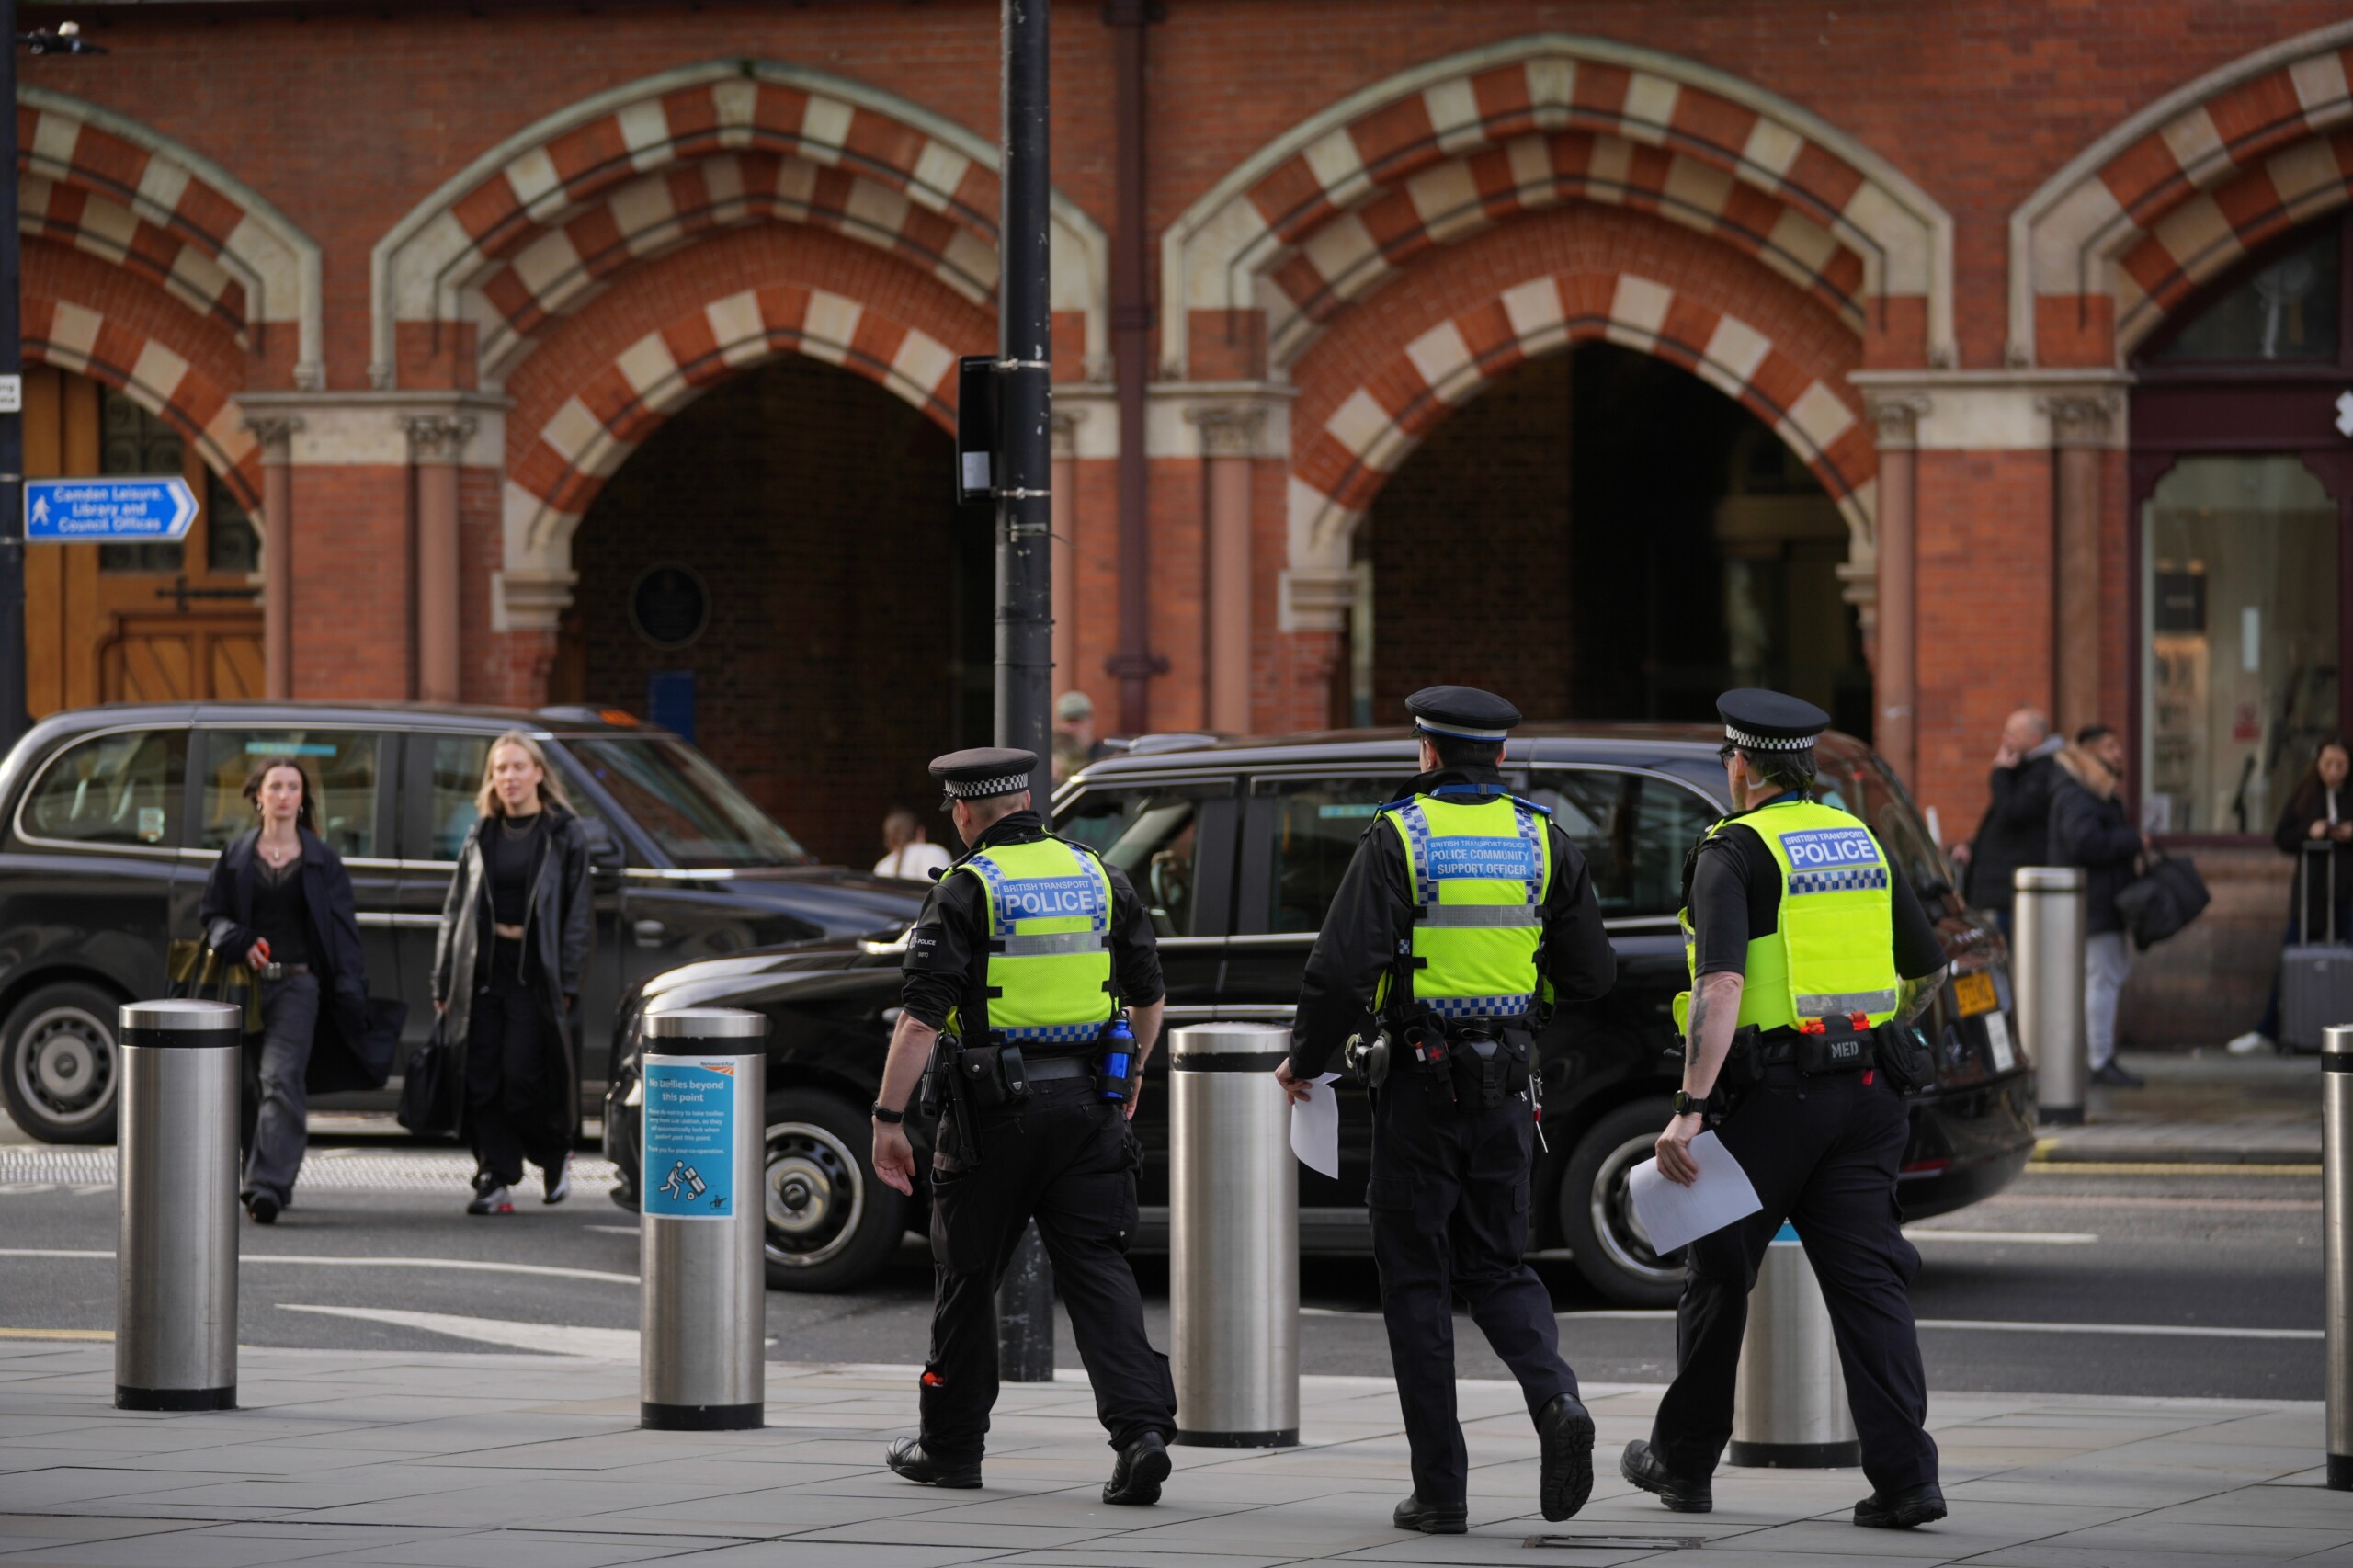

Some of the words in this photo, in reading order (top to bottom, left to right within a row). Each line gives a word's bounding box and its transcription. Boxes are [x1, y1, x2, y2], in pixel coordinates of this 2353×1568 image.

[122, 501, 147, 517] and
[1784, 835, 1817, 845] BRITISH
[1818, 831, 1865, 840] TRANSPORT
[1431, 849, 1468, 860] POLICE
[1471, 850, 1529, 861] COMMUNITY
[1789, 839, 1875, 865] POLICE
[1438, 863, 1483, 874] SUPPORT
[1486, 864, 1527, 874] OFFICER
[1003, 882, 1038, 892] BRITISH
[1039, 880, 1090, 890] TRANSPORT
[1006, 890, 1095, 915] POLICE
[1831, 1041, 1859, 1058] MED
[649, 1078, 659, 1087] No
[660, 1079, 688, 1089] trollies
[689, 1080, 724, 1091] beyond
[662, 1092, 677, 1101] this
[679, 1093, 704, 1103] point
